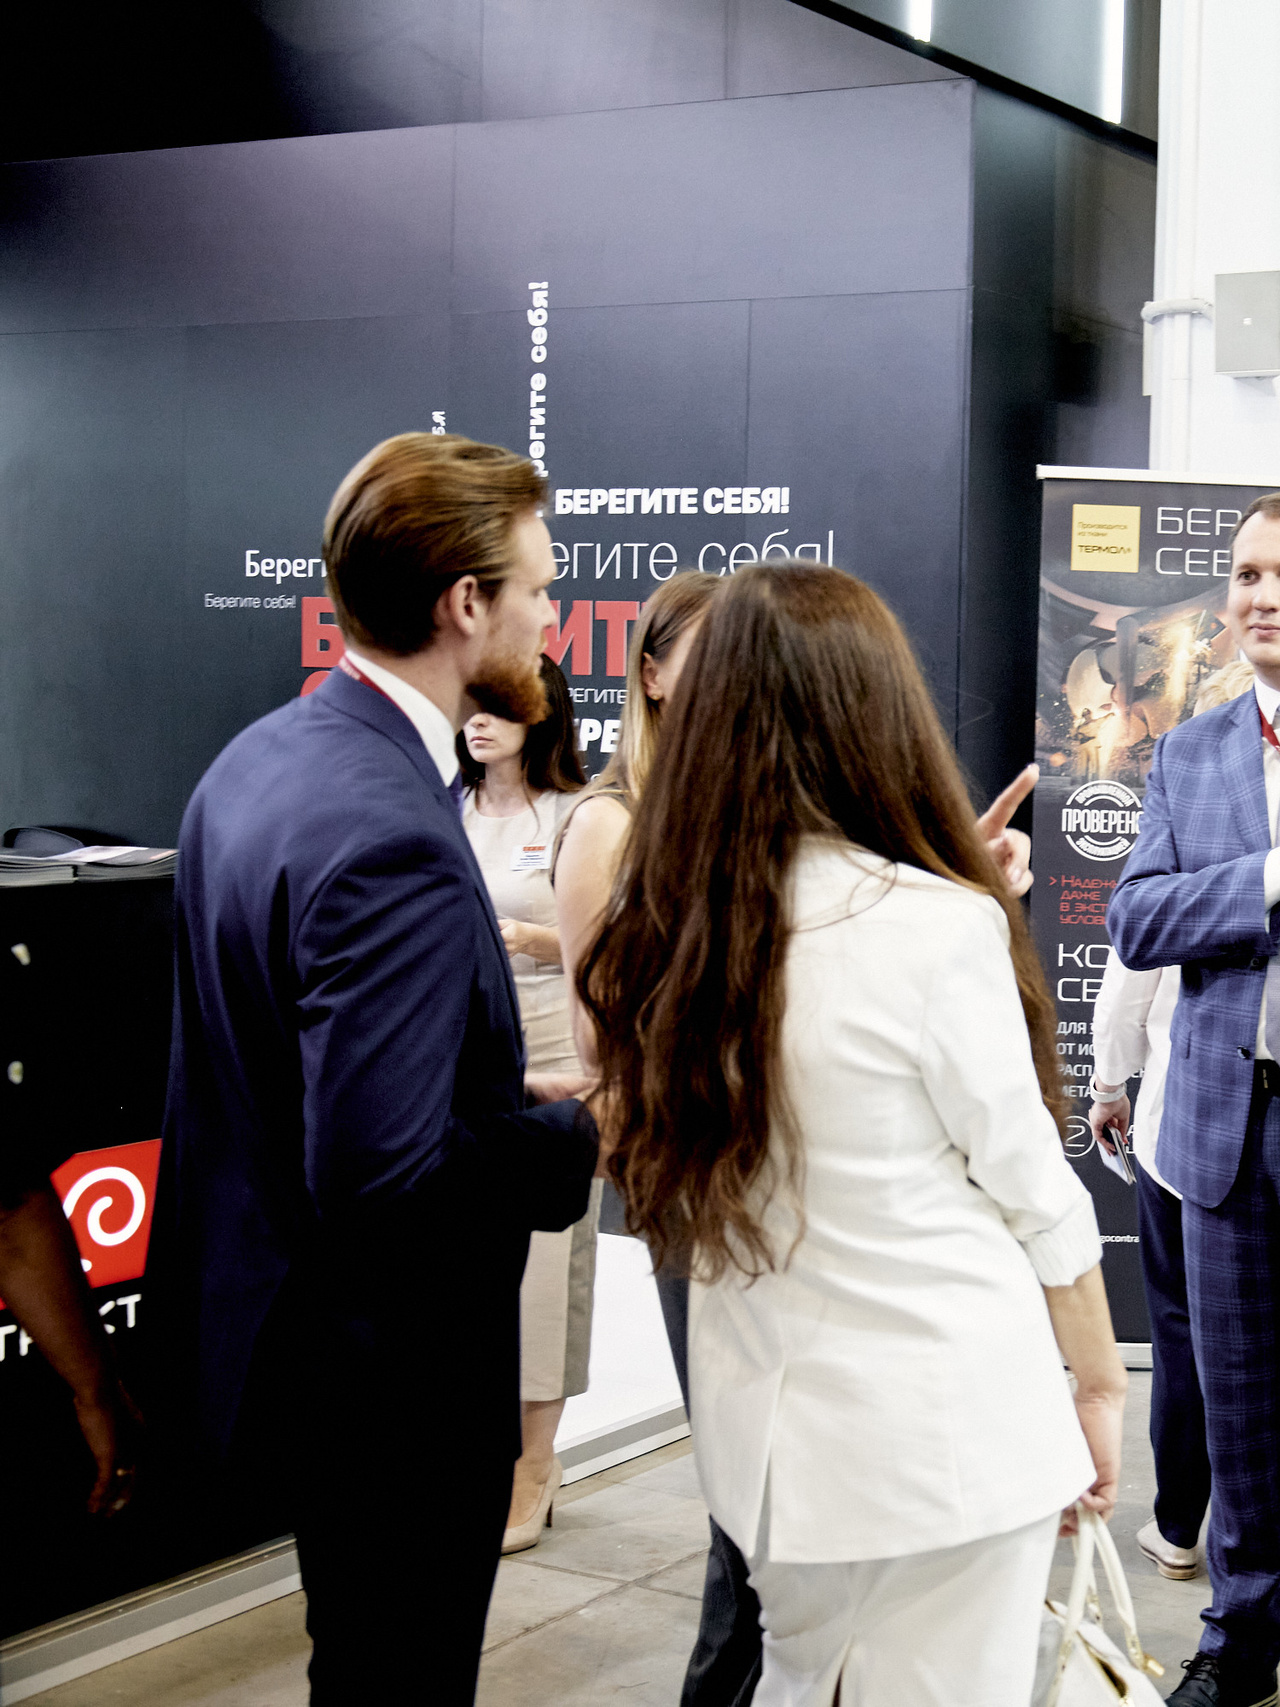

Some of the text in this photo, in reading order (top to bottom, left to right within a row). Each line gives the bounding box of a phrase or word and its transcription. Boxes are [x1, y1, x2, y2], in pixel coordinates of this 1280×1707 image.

[527, 281, 549, 363] себя!
[554, 486, 791, 516] БЕРЕГИТЕ СЕБЯ!
[204, 592, 297, 611] Берегите себя!
[1074, 902, 1109, 913] ЭКСТ
[1059, 914, 1107, 925] УСЛОВ
[1057, 943, 1111, 969] КО
[1056, 1021, 1087, 1036] ДЛЯ
[1056, 1042, 1076, 1055] ОТ
